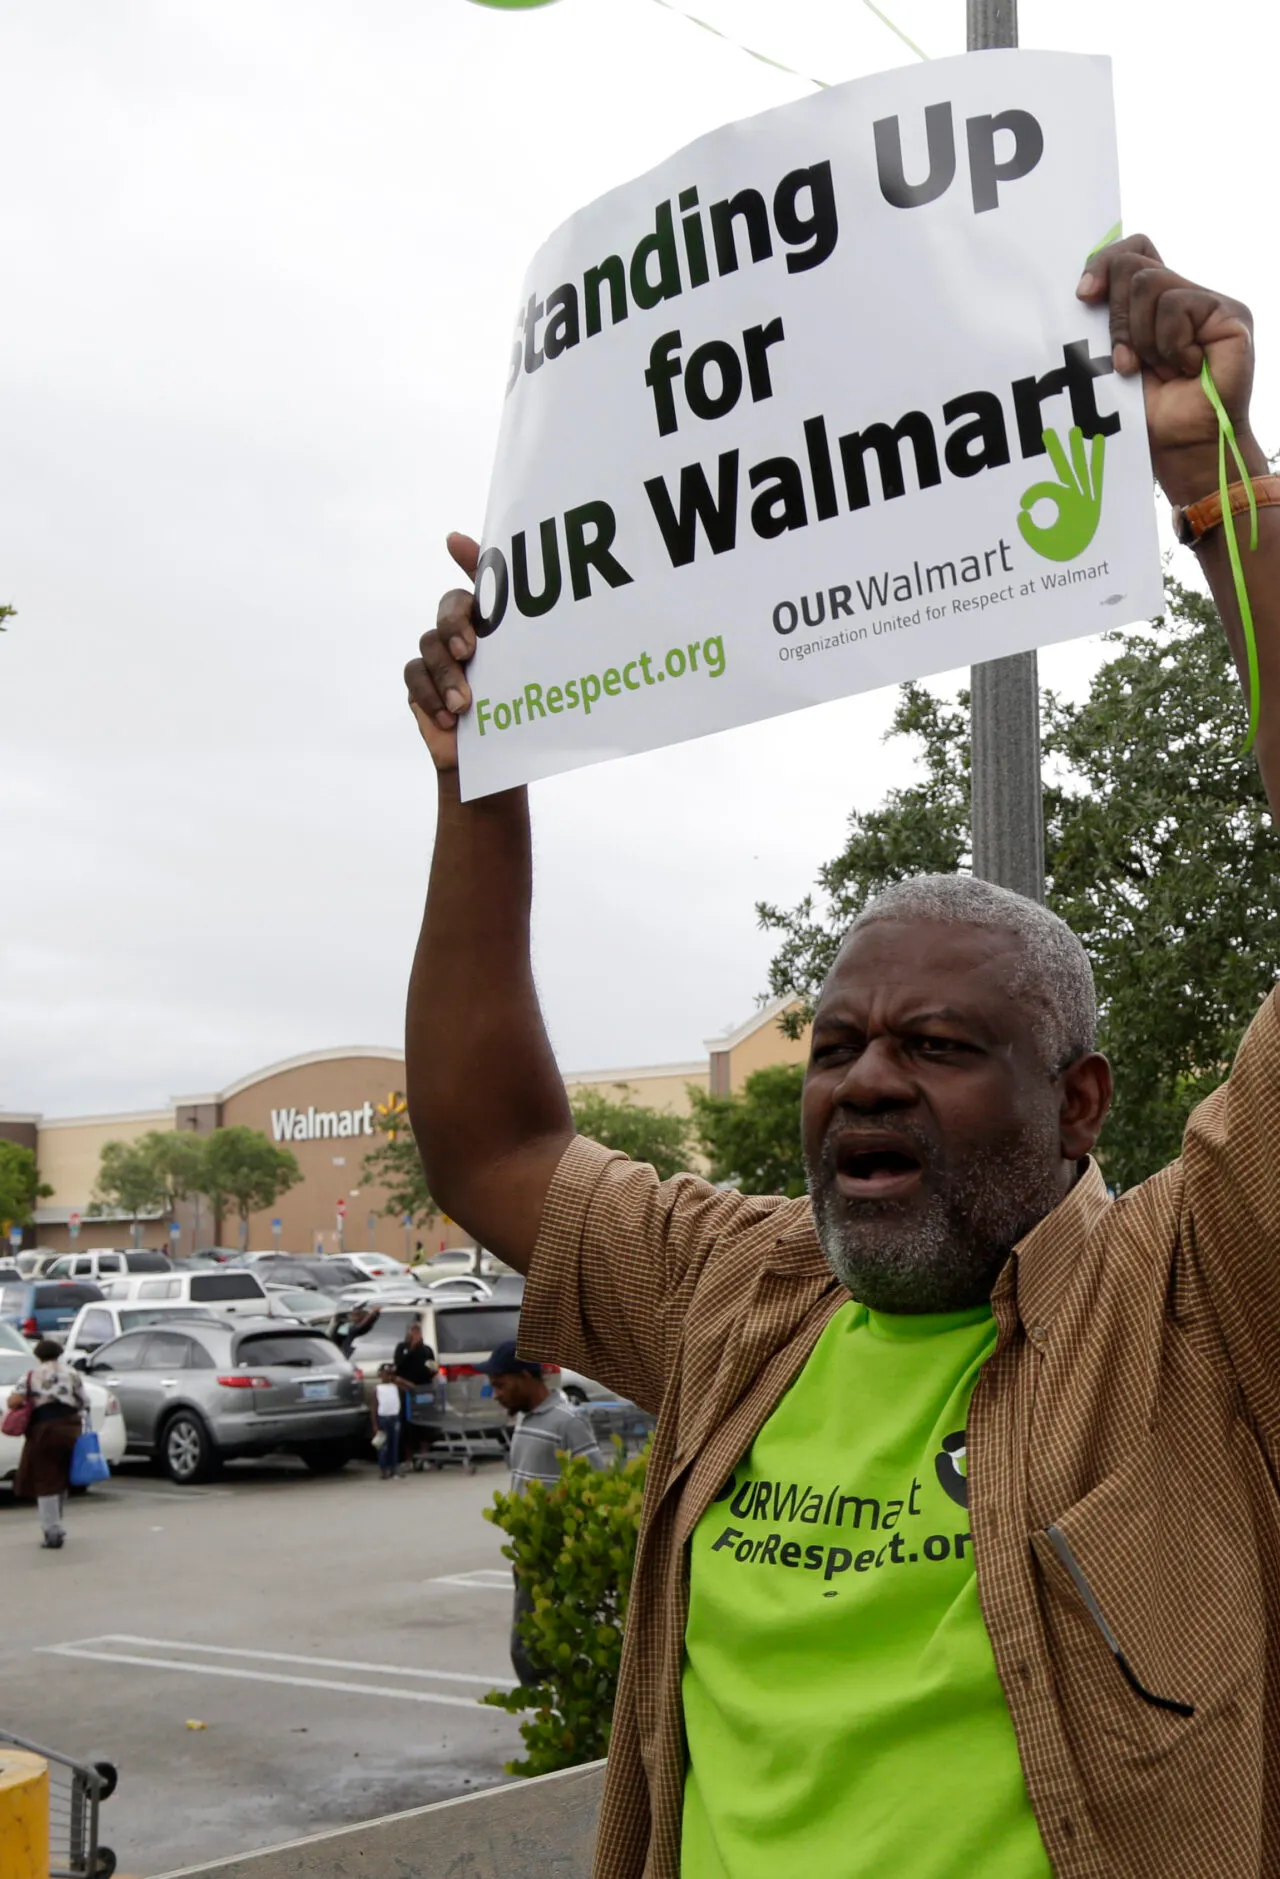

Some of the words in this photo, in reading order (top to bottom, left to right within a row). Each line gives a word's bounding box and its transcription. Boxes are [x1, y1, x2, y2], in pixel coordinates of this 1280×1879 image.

[873, 100, 1044, 214] Up
[644, 316, 785, 437] for
[475, 500, 635, 639] OUR
[643, 338, 1121, 568] Walmart
[779, 626, 868, 662] Organization
[872, 609, 921, 637] United
[925, 603, 947, 622] for
[952, 585, 1014, 614] Respect
[1020, 580, 1036, 596] at
[1041, 560, 1109, 591] Walmart
[476, 635, 726, 736] ForRespect.org
[271, 1101, 374, 1141] Walmart
[711, 1527, 971, 1581] ForRespect.or
